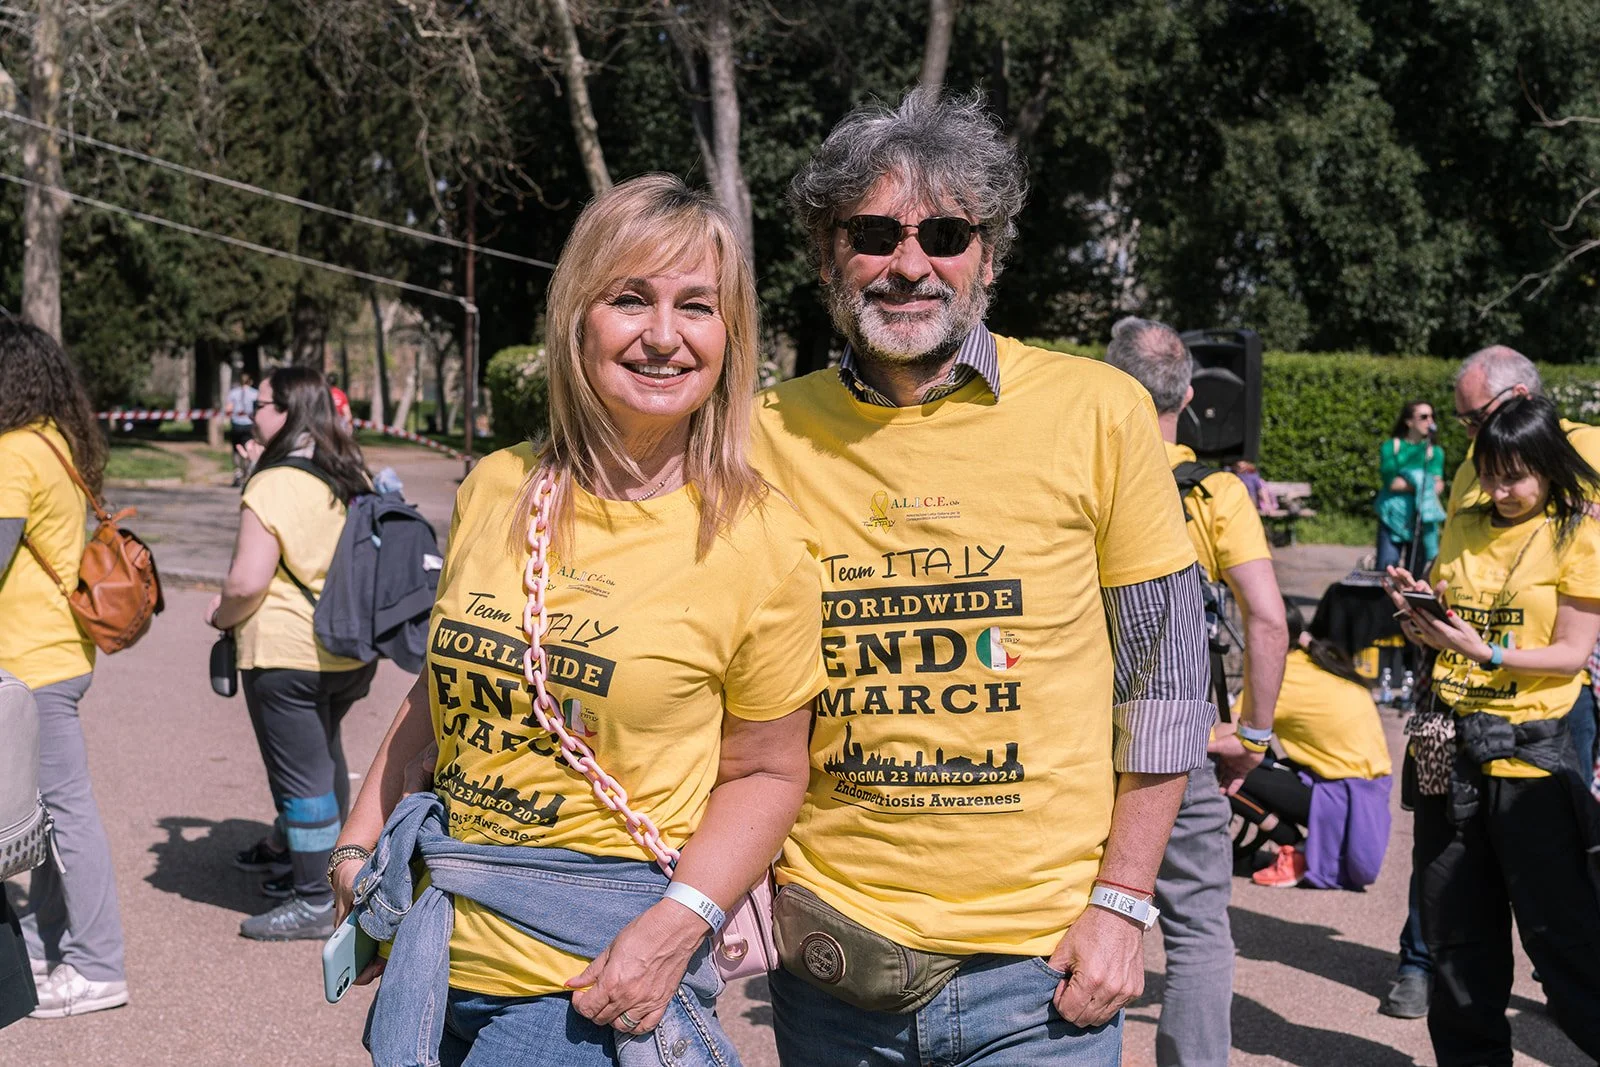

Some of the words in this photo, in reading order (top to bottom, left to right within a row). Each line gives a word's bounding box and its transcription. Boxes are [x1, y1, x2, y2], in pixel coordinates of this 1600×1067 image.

[820, 554, 875, 583] Team
[881, 545, 1005, 579] ITALY
[1451, 586, 1473, 601] Team
[464, 592, 512, 623] Team
[515, 612, 619, 648] TALY
[437, 626, 604, 688] WORLIDE
[821, 626, 968, 678] END
[818, 682, 1021, 717] MARCH
[442, 712, 586, 770] ARC
[455, 786, 474, 801] 23
[834, 780, 925, 807] Endometriosis
[929, 793, 1021, 807] Awareness
[890, 770, 909, 783] 23
[914, 771, 974, 783] MARZO
[978, 769, 1018, 783] 2024
